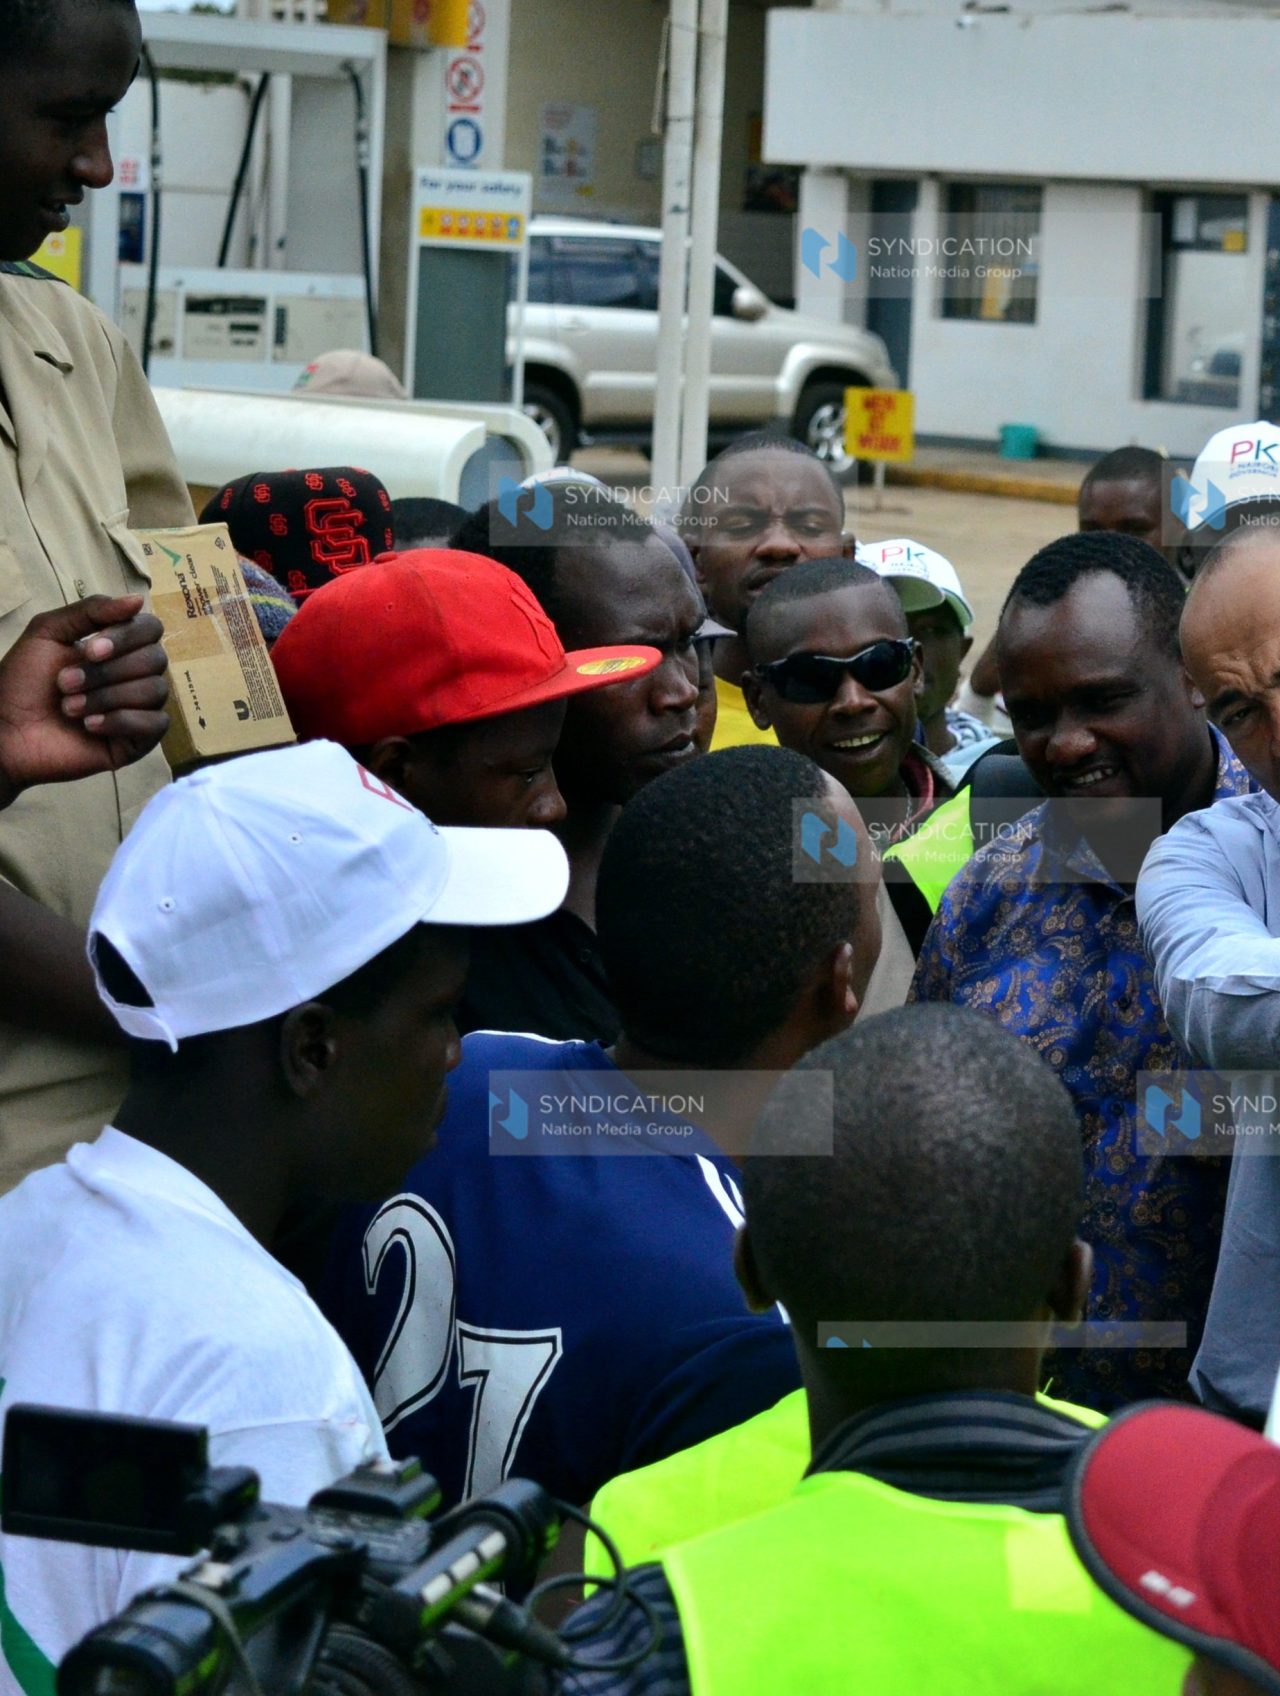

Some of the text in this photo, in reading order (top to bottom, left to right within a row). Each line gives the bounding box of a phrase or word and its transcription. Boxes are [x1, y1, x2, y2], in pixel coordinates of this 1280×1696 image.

[1229, 439, 1280, 465] PK
[177, 572, 197, 619] Rexona
[361, 1192, 564, 1504] 27
